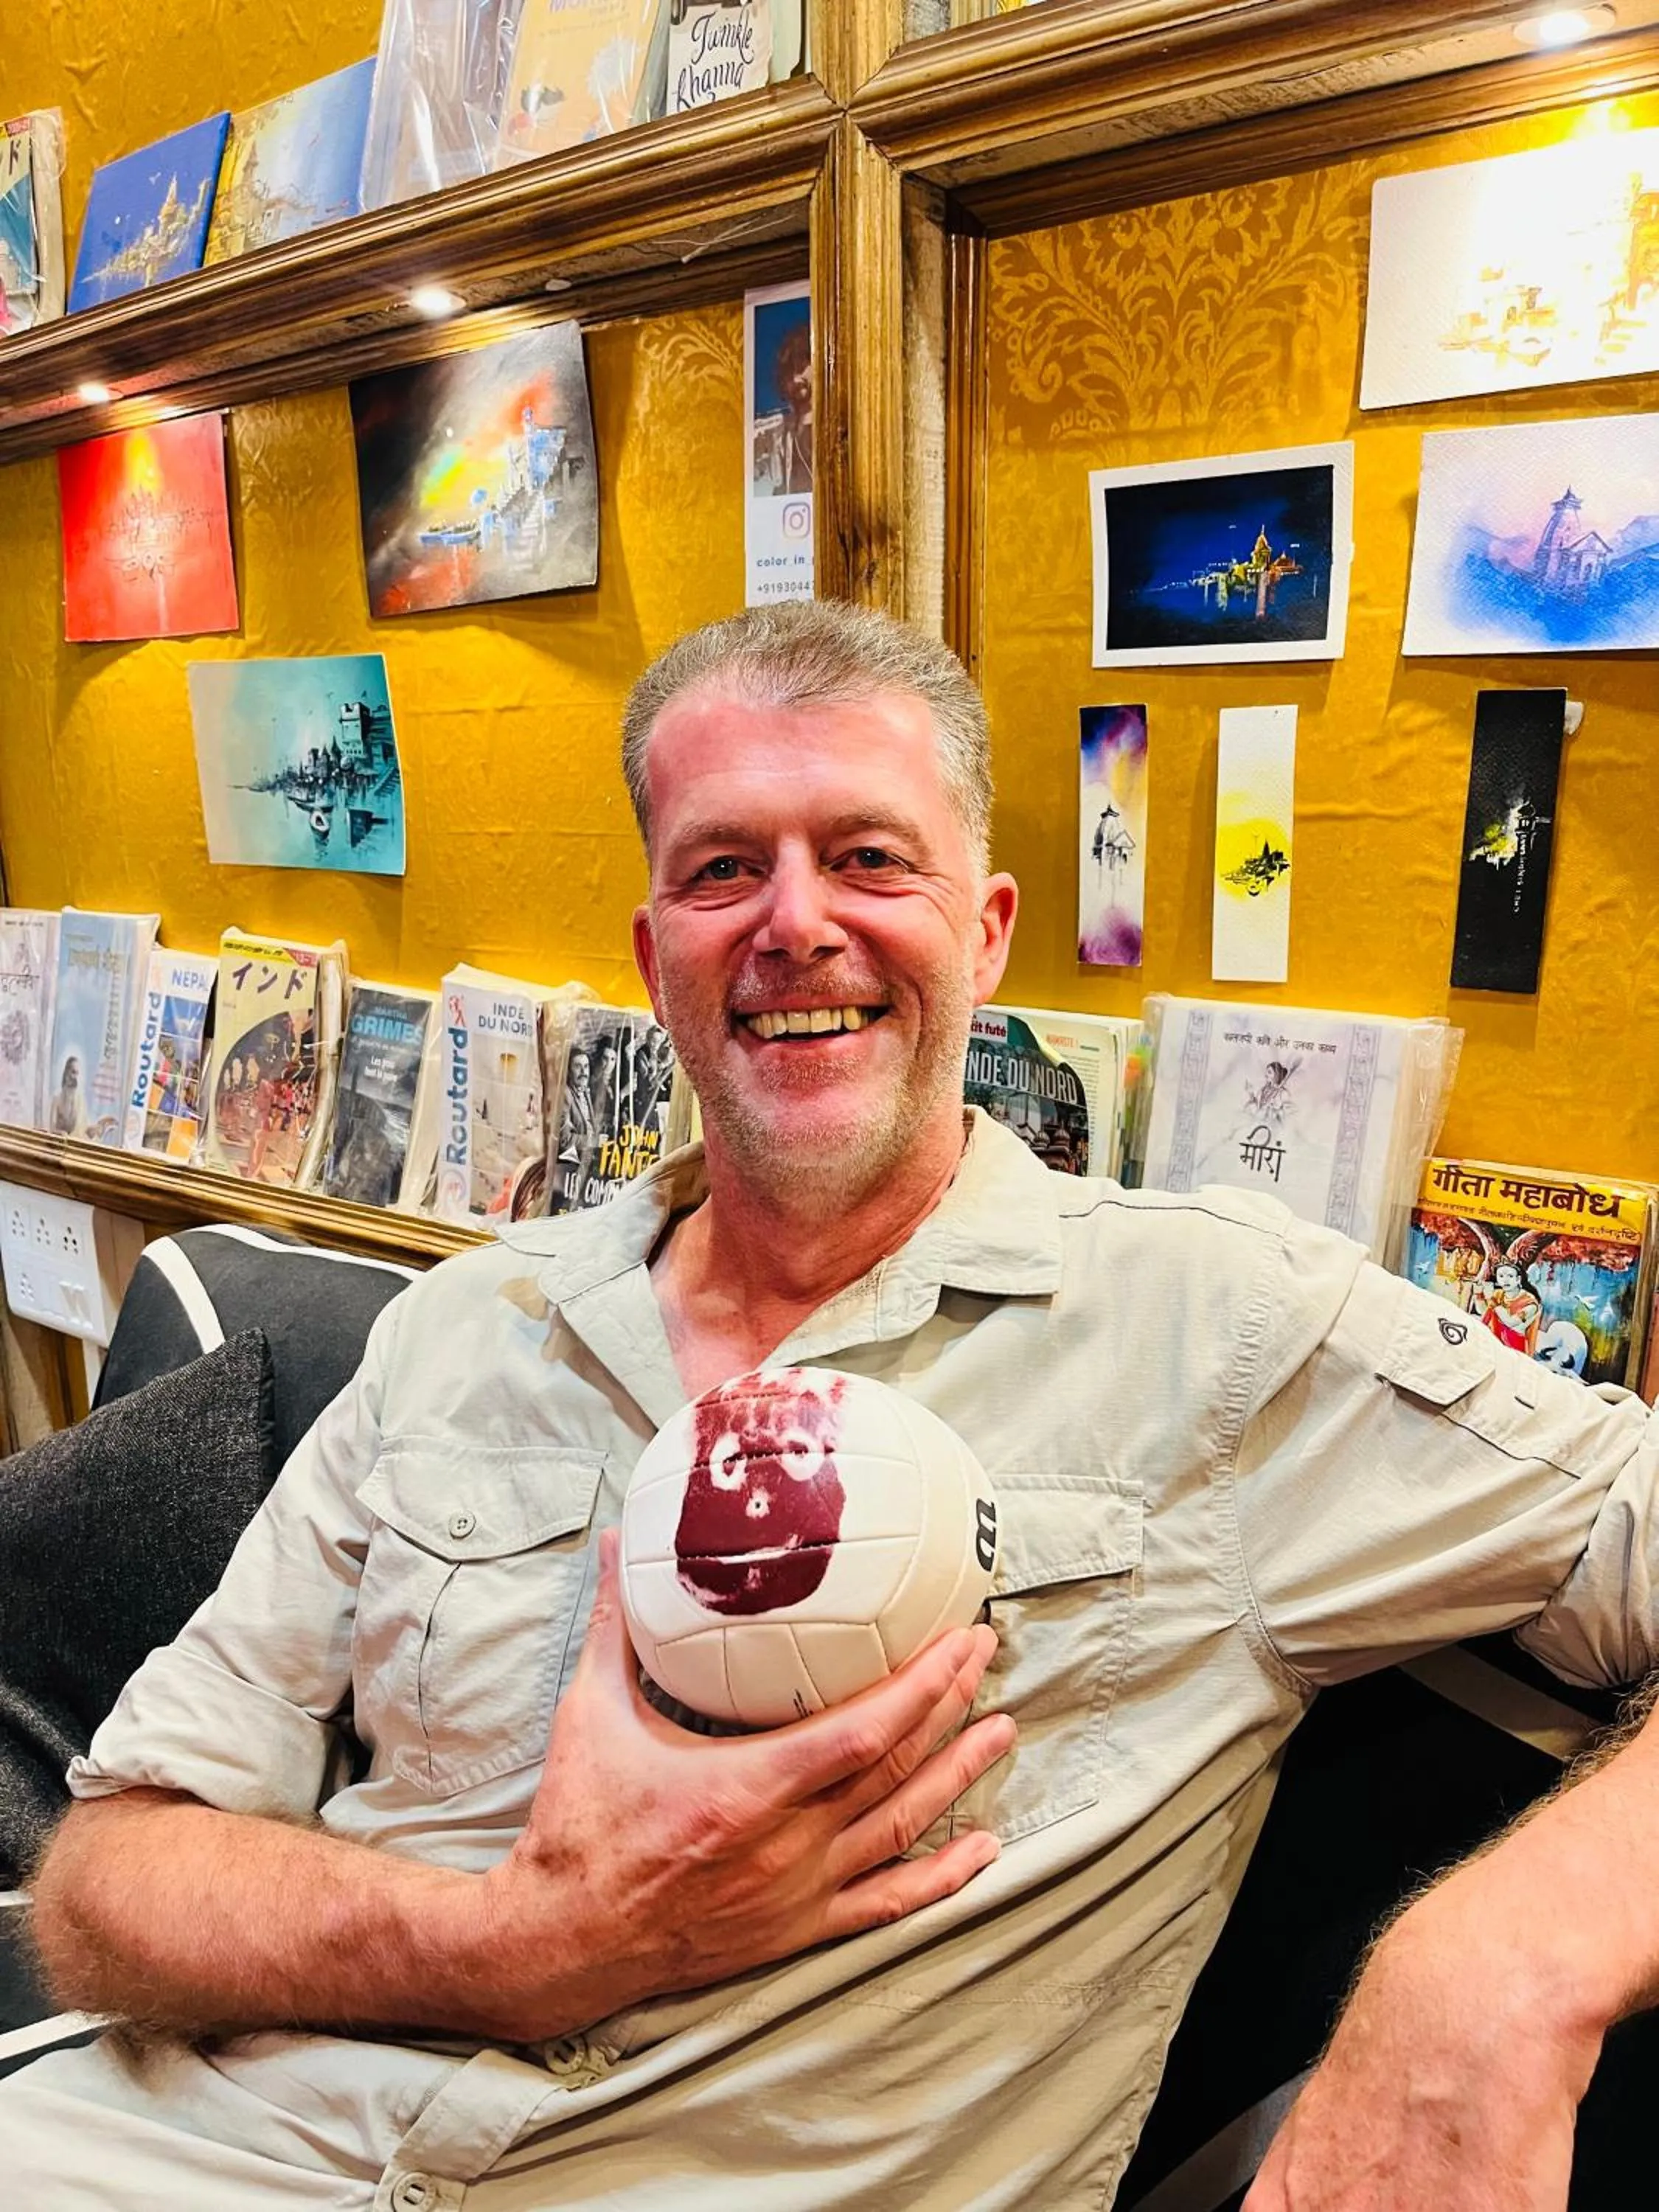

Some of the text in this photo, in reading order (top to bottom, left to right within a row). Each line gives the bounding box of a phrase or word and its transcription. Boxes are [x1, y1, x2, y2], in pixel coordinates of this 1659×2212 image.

[691, 3, 755, 65] Twinkle
[232, 961, 307, 1000] インド
[351, 1014, 424, 1046] GRIMES
[479, 1015, 496, 1029] DU
[493, 1002, 525, 1020] INDE
[131, 991, 164, 1107] Routard
[446, 1026, 468, 1166] Routard
[967, 1050, 1078, 1105] NDE DU NORD
[619, 1124, 659, 1151] JOHN
[1433, 1164, 1495, 1198] गीता
[1499, 1179, 1626, 1218] महाबोध
